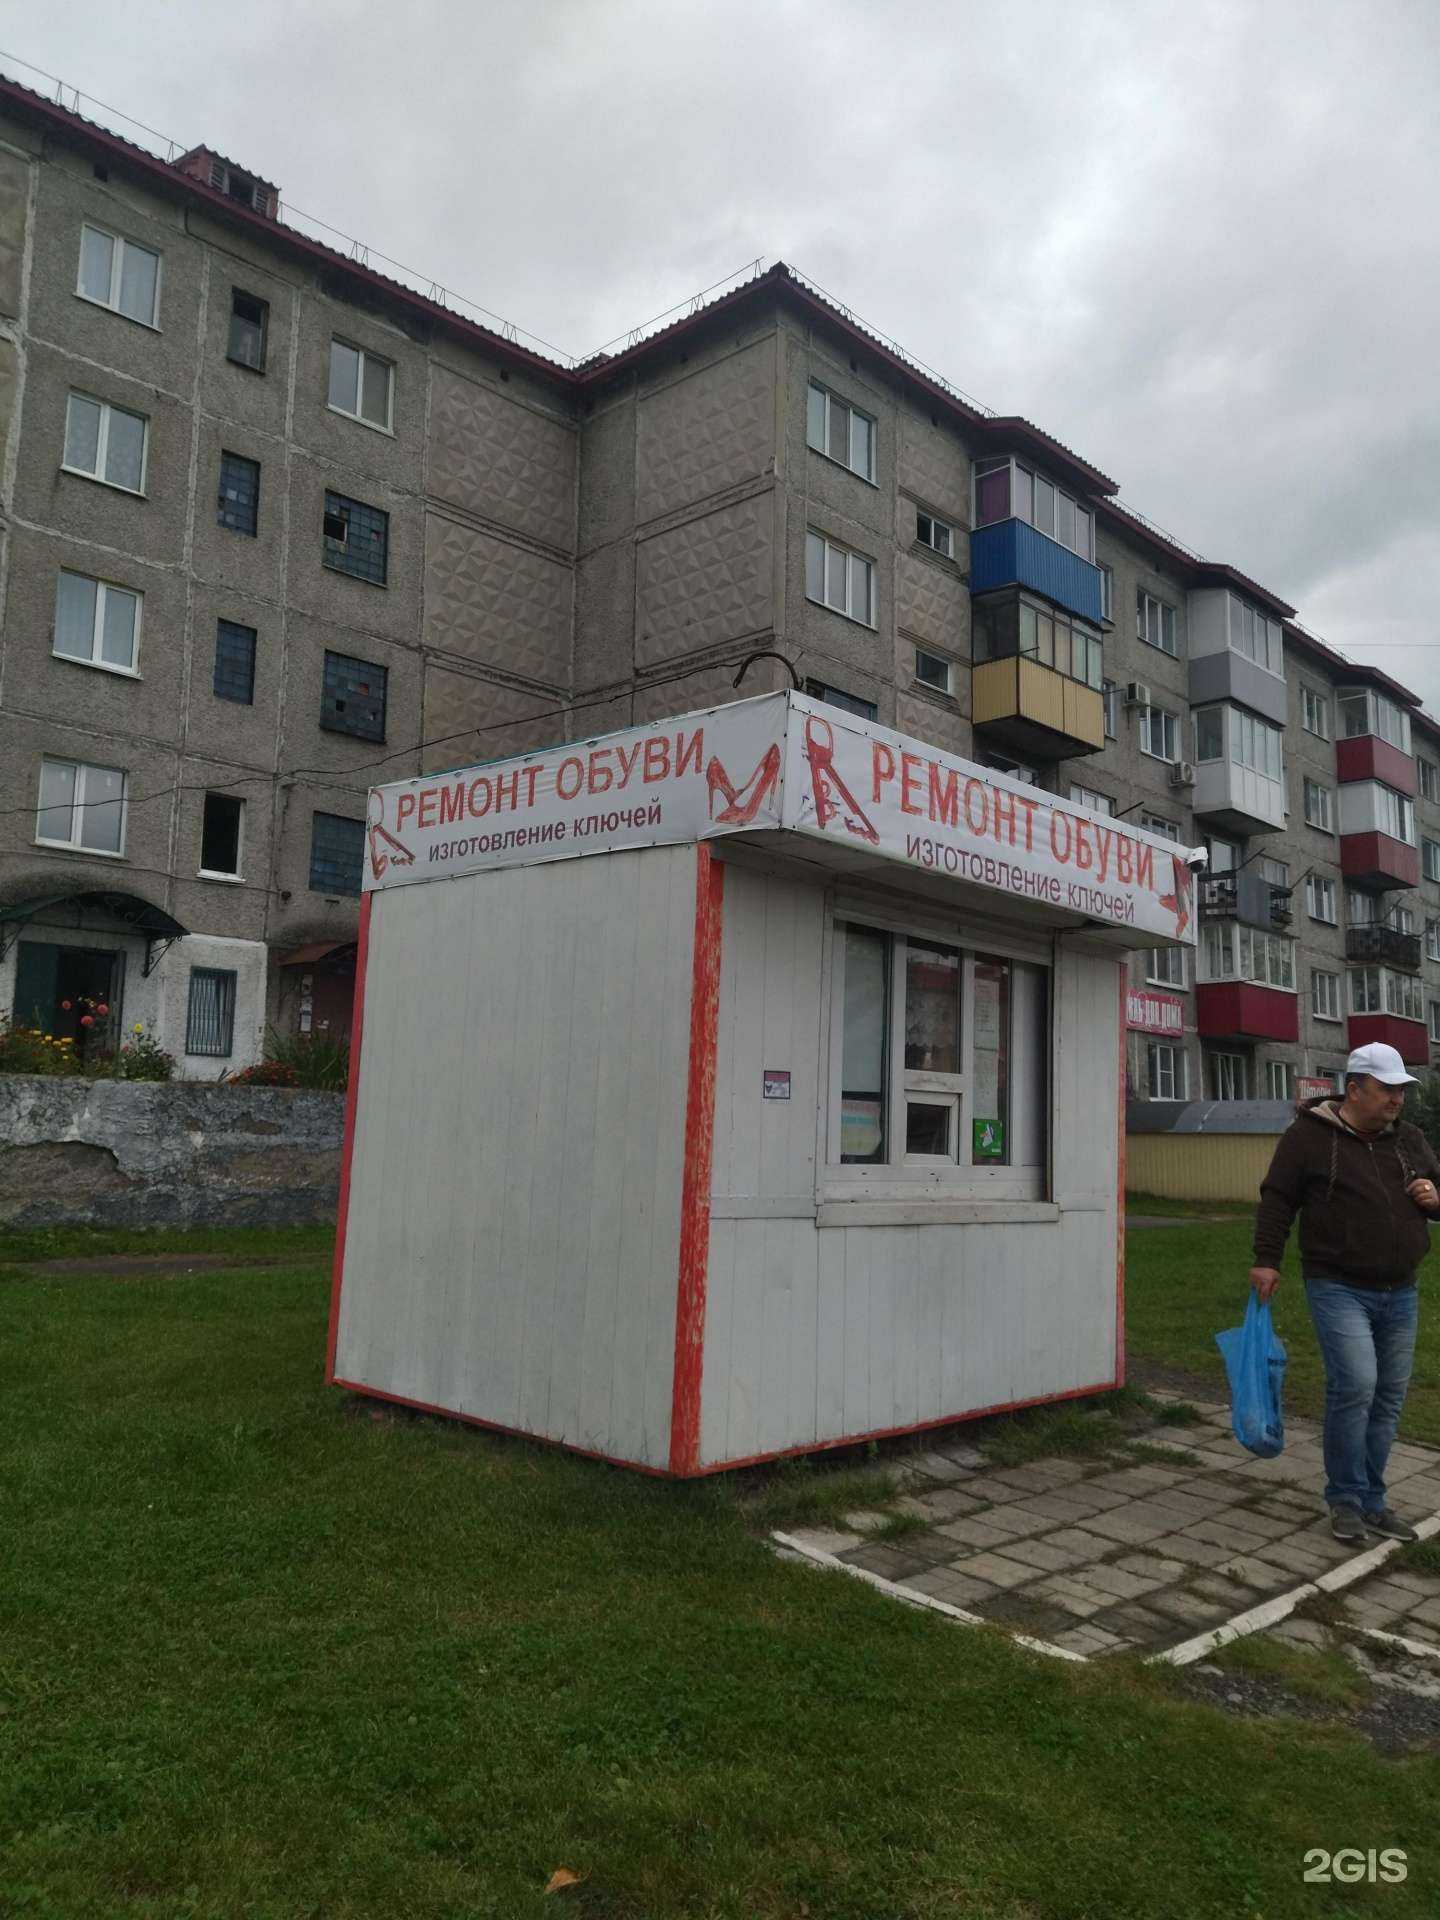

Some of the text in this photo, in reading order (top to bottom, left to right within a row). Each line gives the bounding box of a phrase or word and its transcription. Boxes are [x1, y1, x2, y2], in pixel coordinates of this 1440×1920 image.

[396, 728, 704, 832] РЕМОНТ ОБУВИ
[872, 741, 1154, 891] РЕМОНТ ОБУВИ
[429, 797, 662, 862] изготовление ключей
[905, 832, 1134, 923] изготовление ключей
